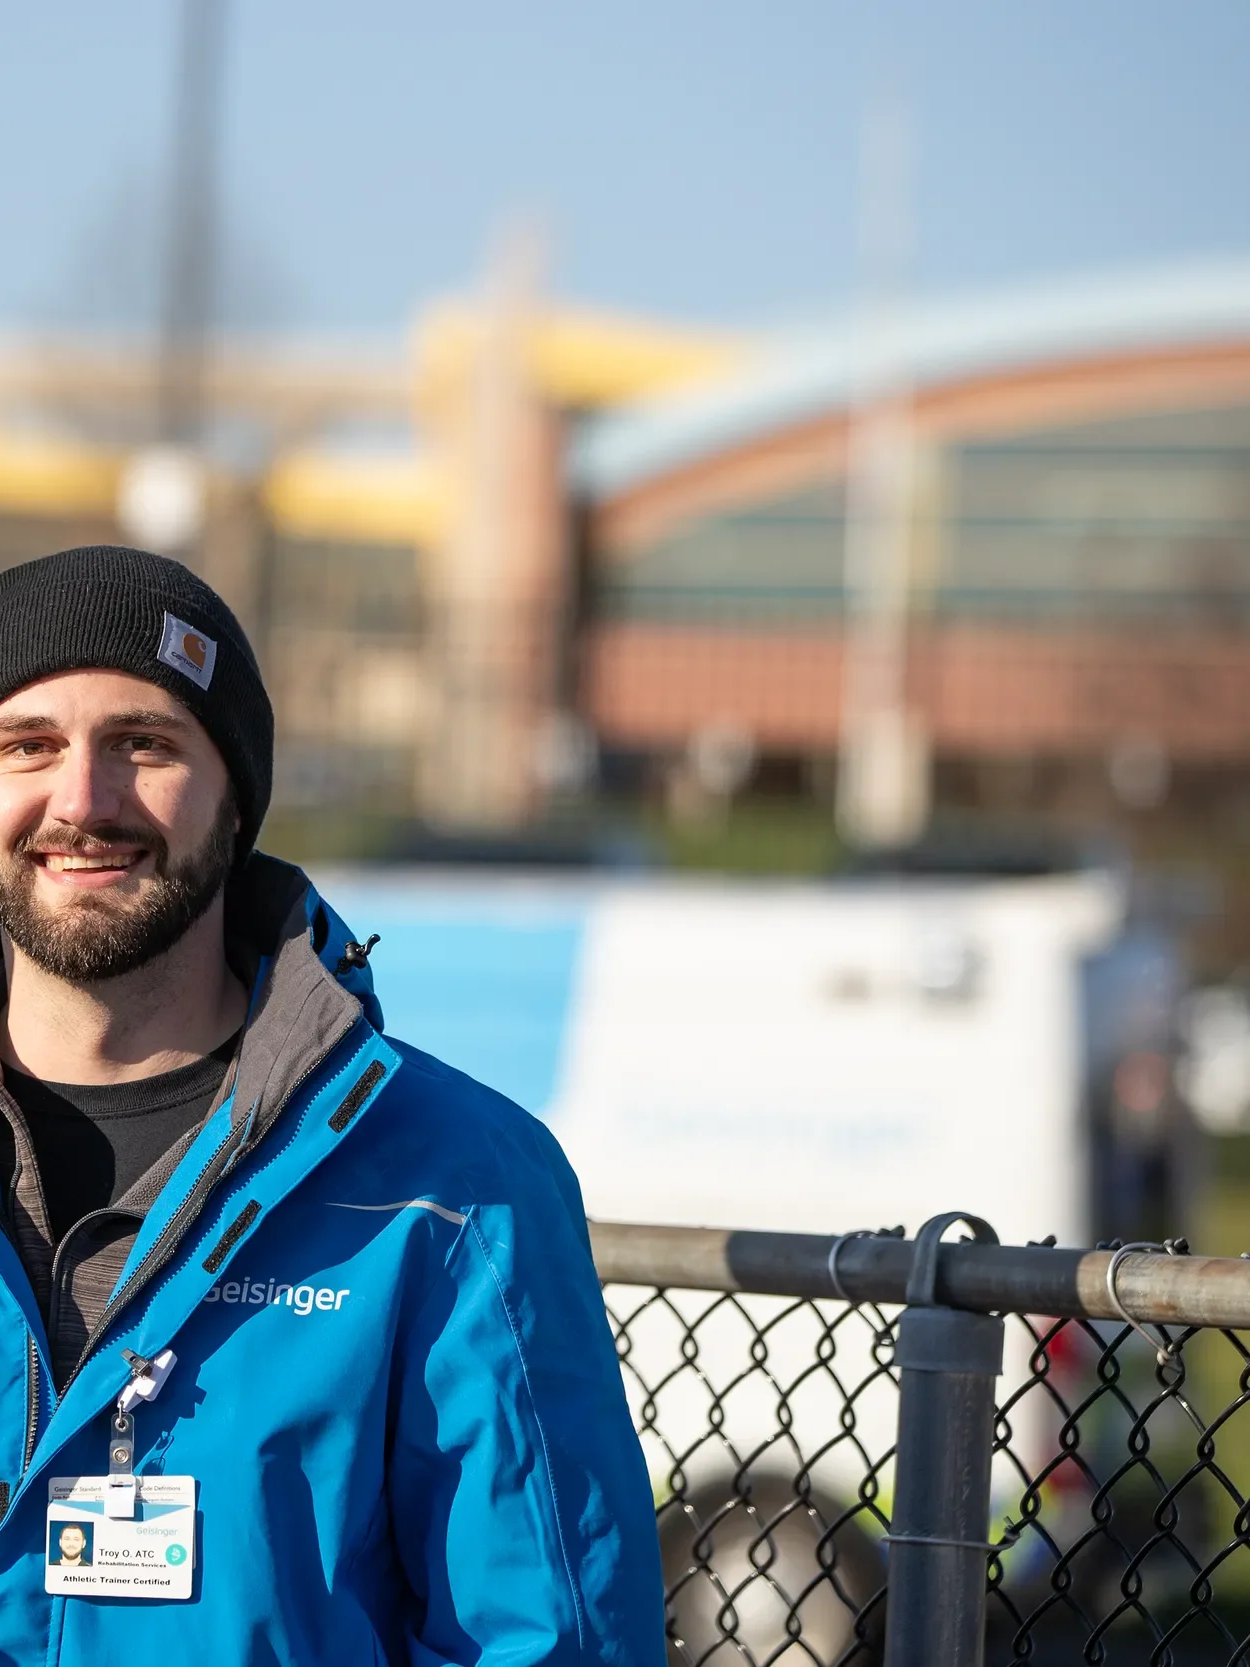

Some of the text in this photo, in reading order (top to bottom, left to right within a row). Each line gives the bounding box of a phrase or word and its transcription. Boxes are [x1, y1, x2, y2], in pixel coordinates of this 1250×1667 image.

[136, 1526, 178, 1537] Geisinger
[99, 1548, 119, 1559] Troy
[135, 1550, 155, 1558] ATC
[63, 1575, 171, 1586] Athletic Trainer Certified
